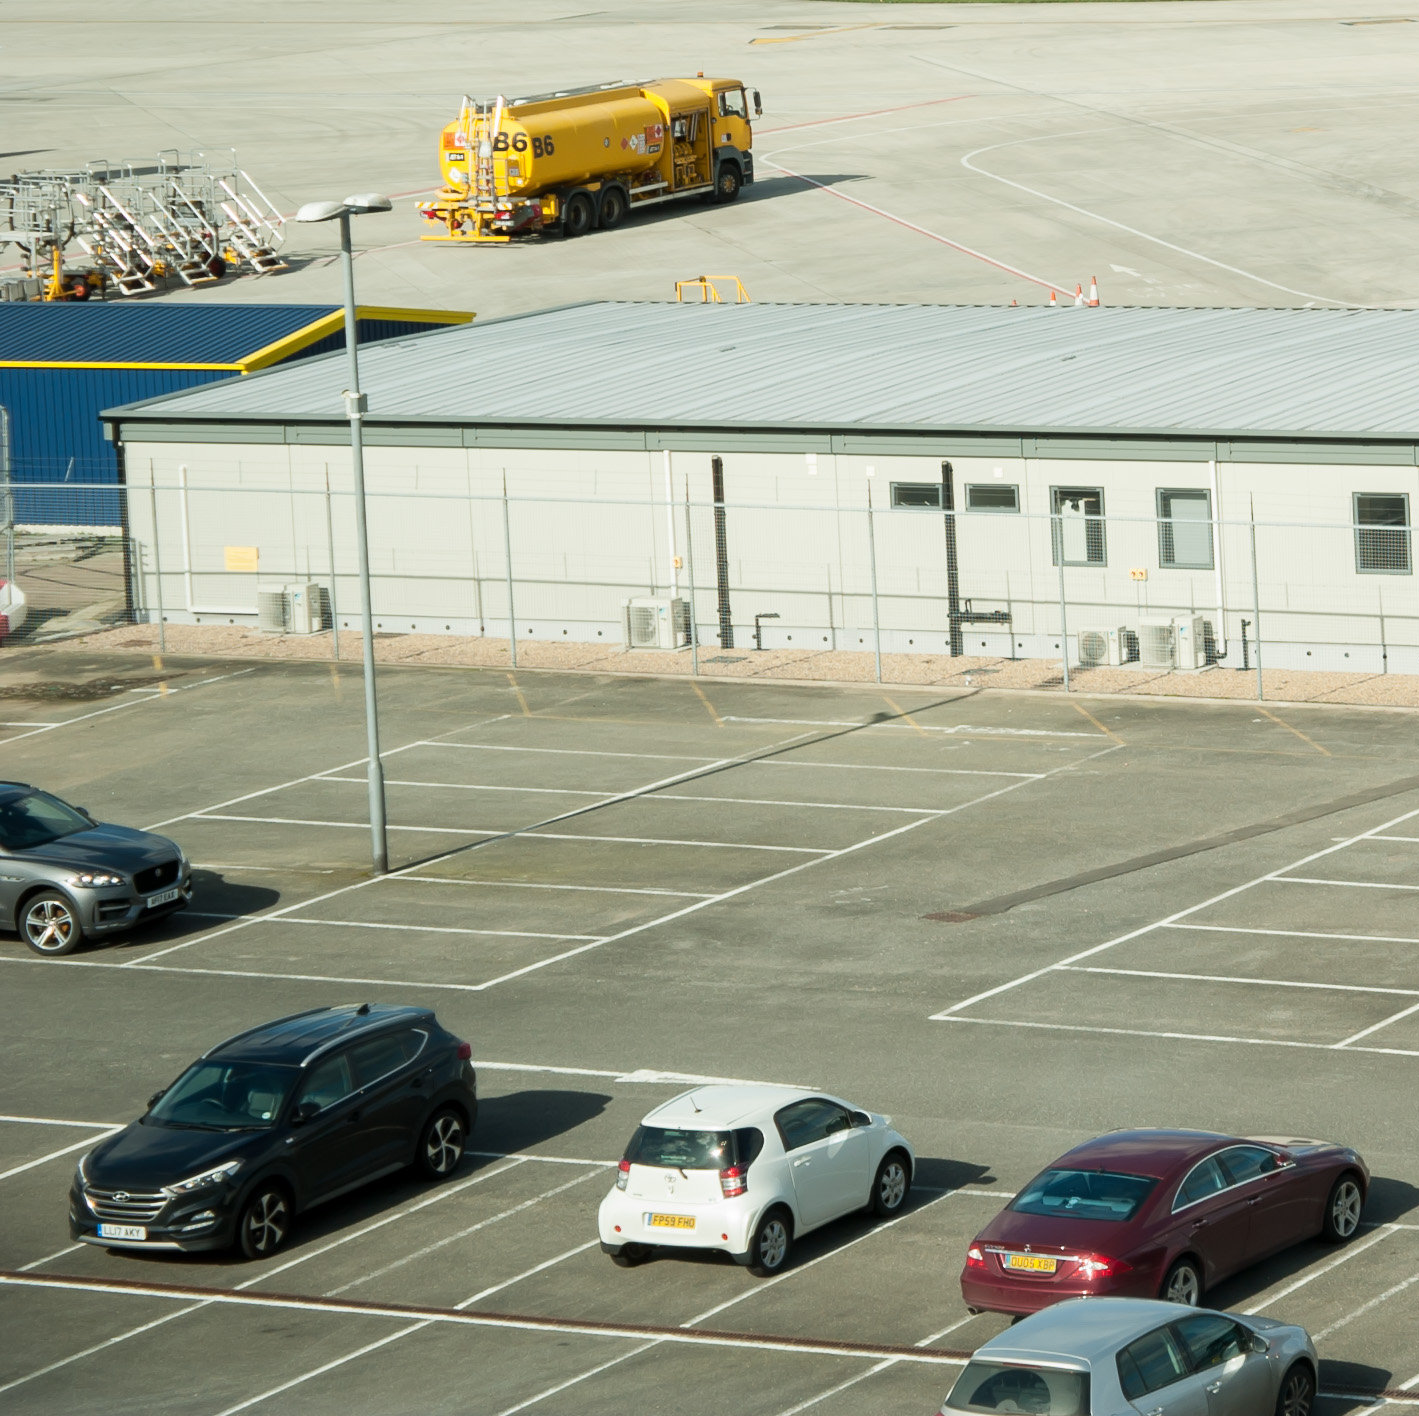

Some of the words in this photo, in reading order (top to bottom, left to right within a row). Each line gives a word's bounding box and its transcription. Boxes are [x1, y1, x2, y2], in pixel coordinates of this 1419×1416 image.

[494, 131, 528, 152] B6
[532, 135, 555, 159] B6
[652, 1215, 676, 1226] FP59
